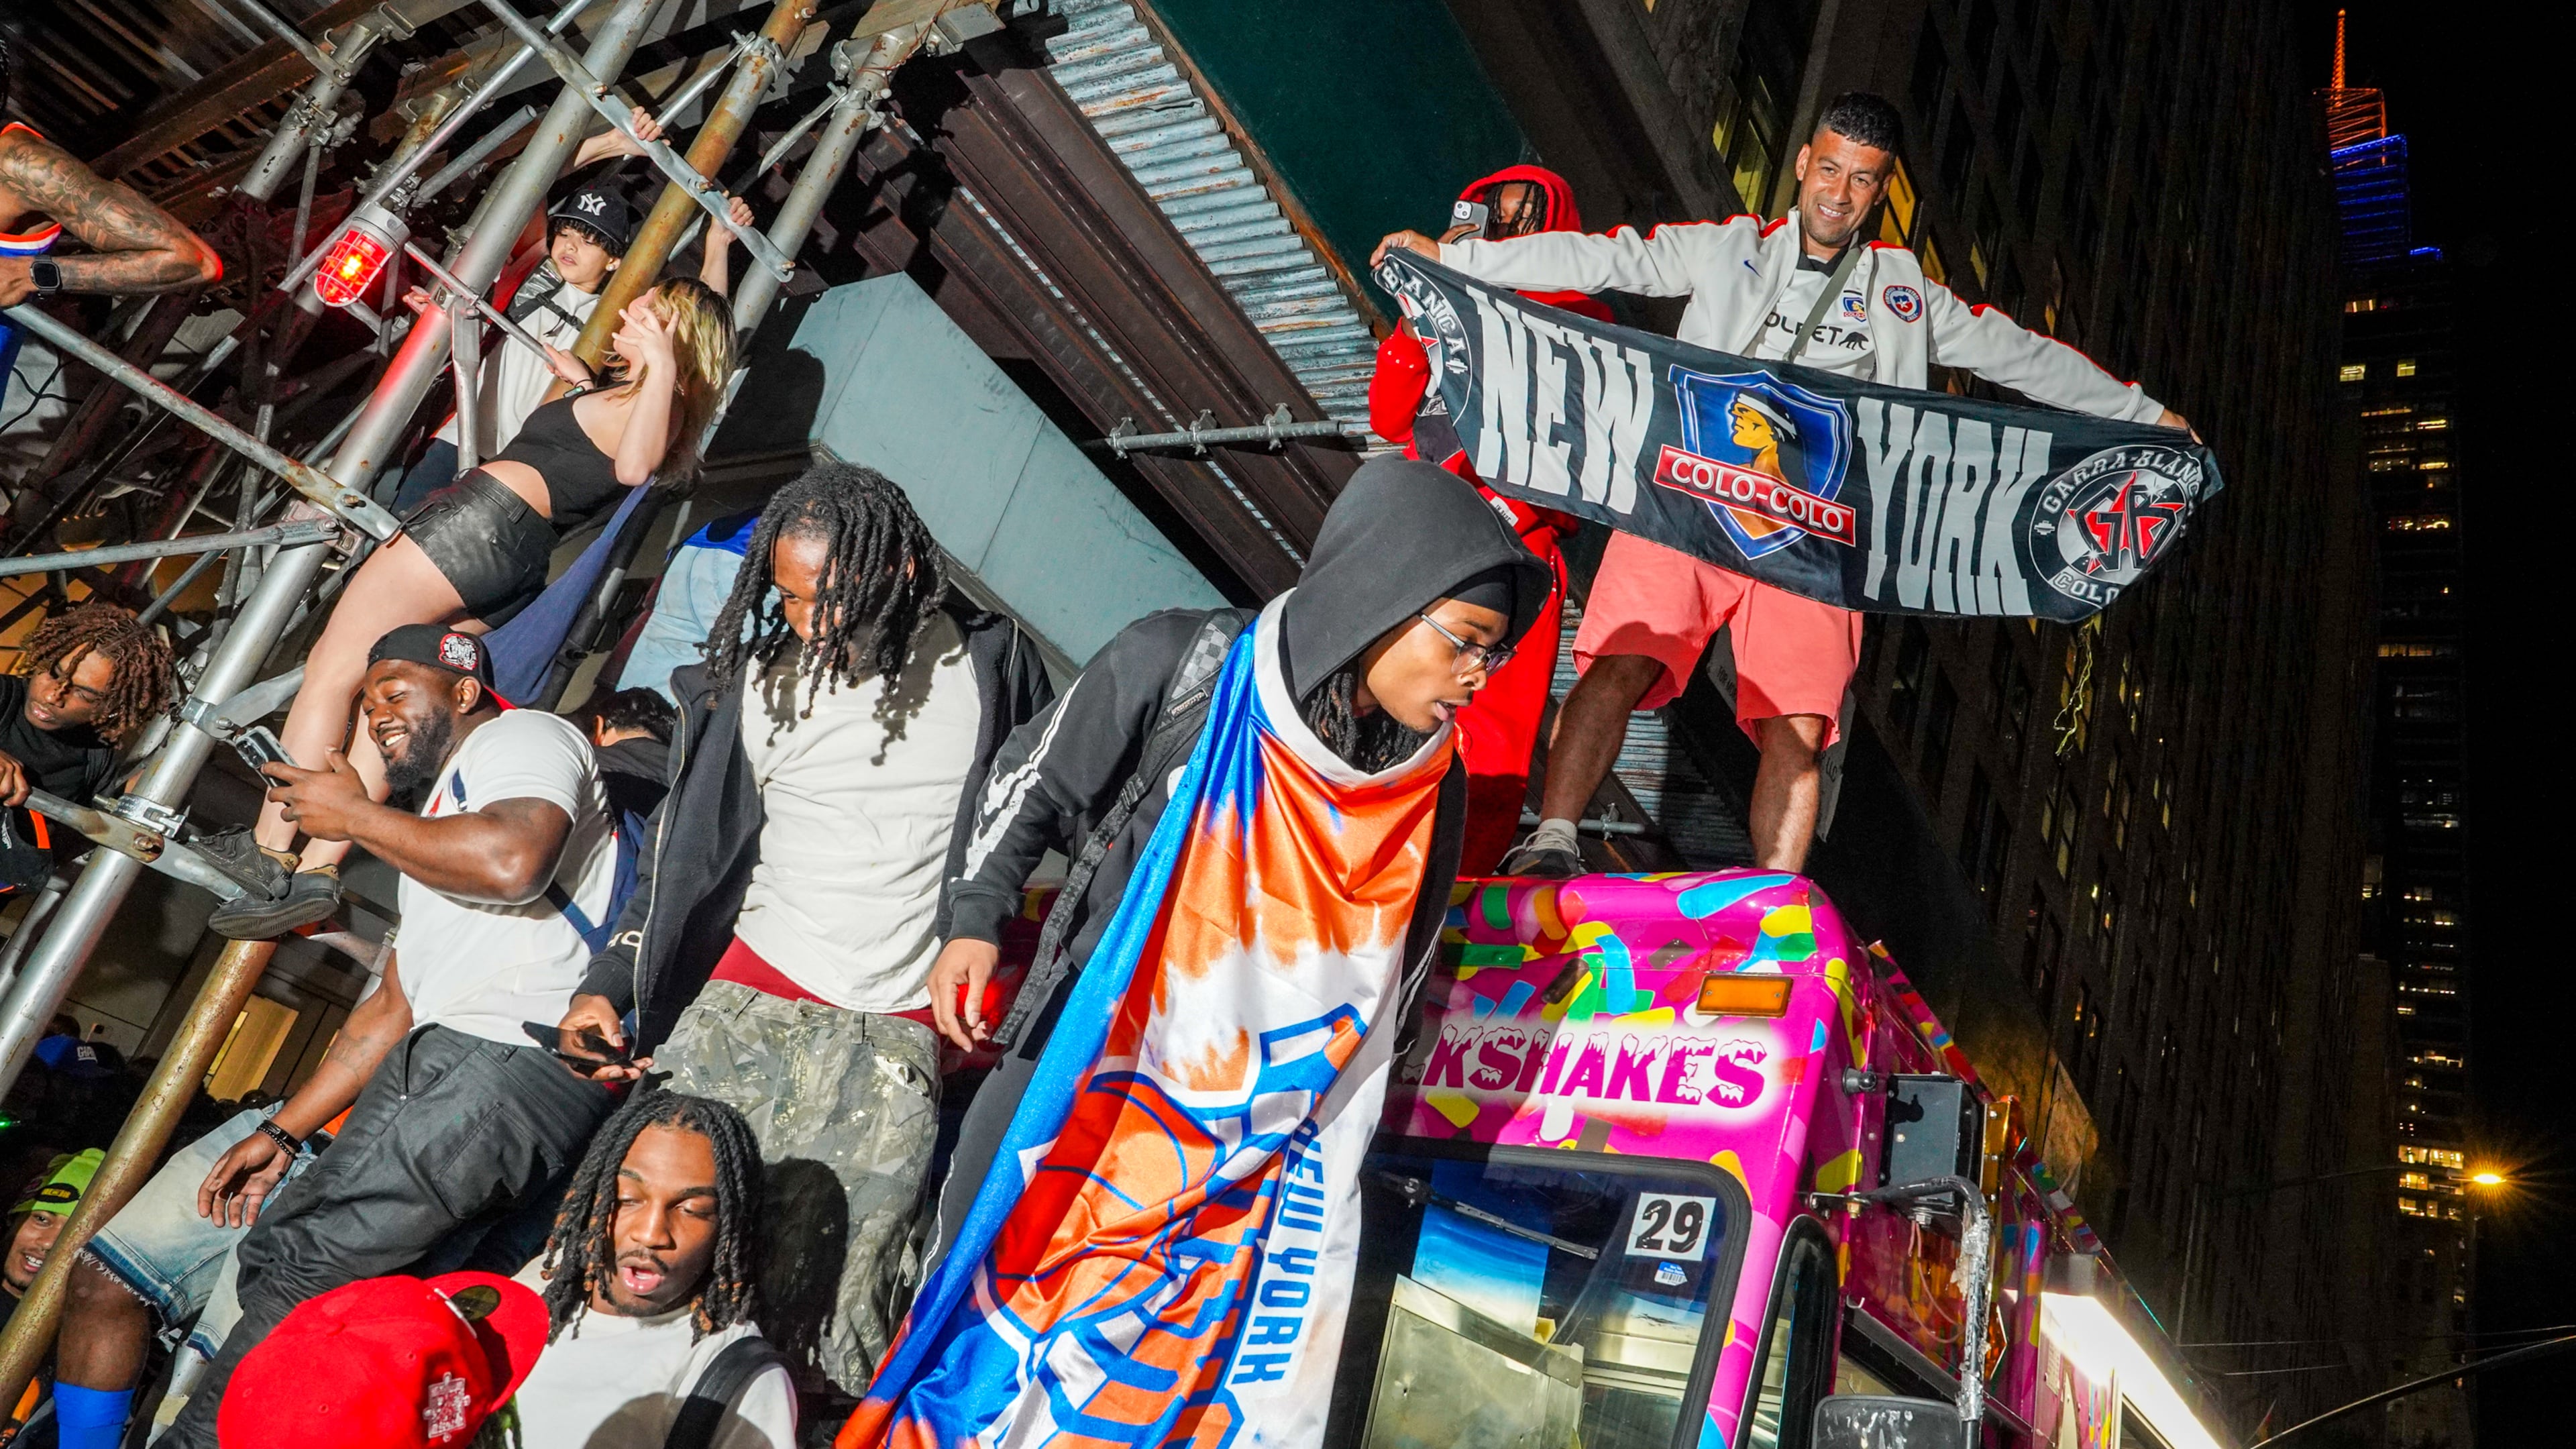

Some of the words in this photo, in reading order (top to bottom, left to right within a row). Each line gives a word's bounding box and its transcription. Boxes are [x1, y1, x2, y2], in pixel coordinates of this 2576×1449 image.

[578, 193, 607, 215] NY
[1381, 263, 1467, 356] BANCA
[1466, 284, 1654, 515] NEW
[1857, 396, 2053, 616] YORK
[2041, 449, 2202, 515] GARRA-BLANC
[1671, 455, 1844, 533] COLO-COLO
[1635, 1199, 1704, 1254] 29
[1230, 1246, 1319, 1385] YORK
